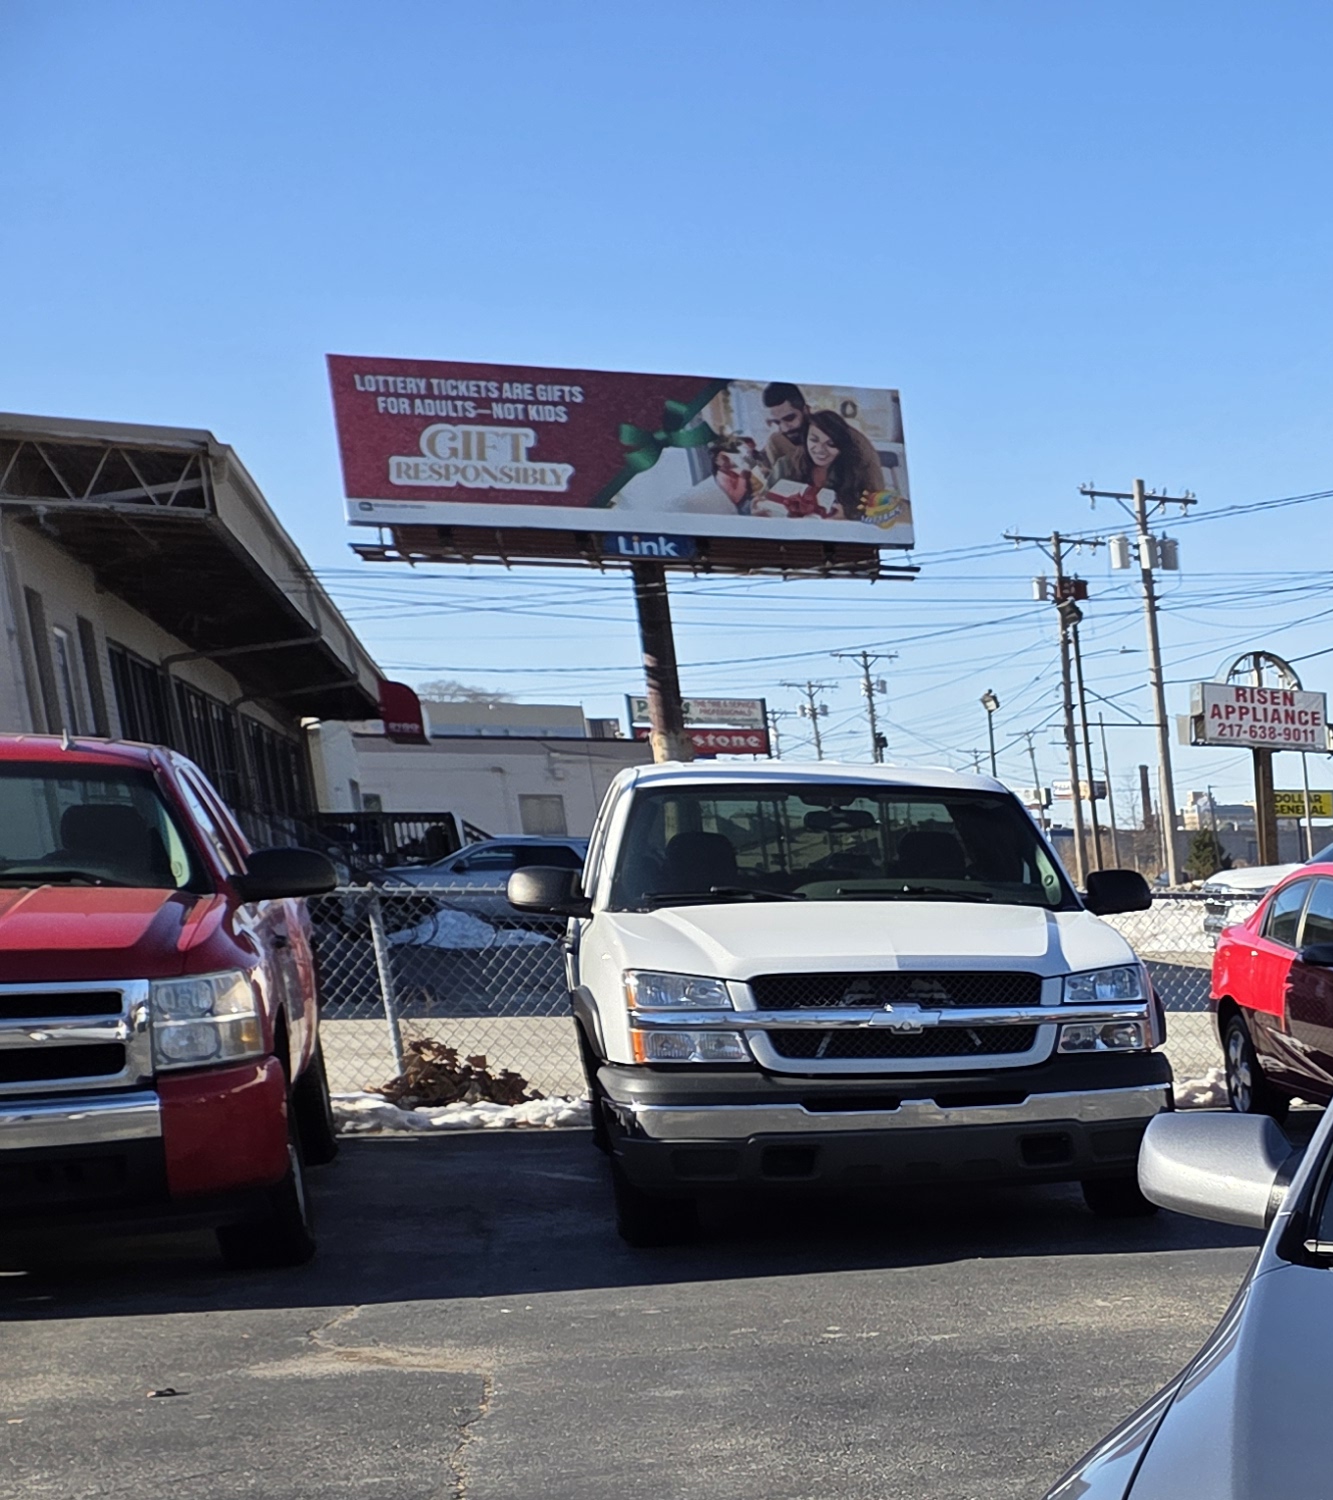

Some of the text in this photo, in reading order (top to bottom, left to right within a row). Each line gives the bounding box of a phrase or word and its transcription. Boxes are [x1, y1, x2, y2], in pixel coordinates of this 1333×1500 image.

[354, 374, 584, 403] LOTTERY TICKETS ARE GIFTS
[377, 397, 411, 414] FOR
[528, 405, 568, 422] KIDS
[426, 429, 530, 462] GIFT
[395, 461, 567, 487] RESPONSIBLY
[618, 535, 680, 556] Link
[1235, 687, 1295, 706] RISEN
[1210, 704, 1321, 726] APPLIANCE
[1218, 723, 1316, 742] 217-638-9011
